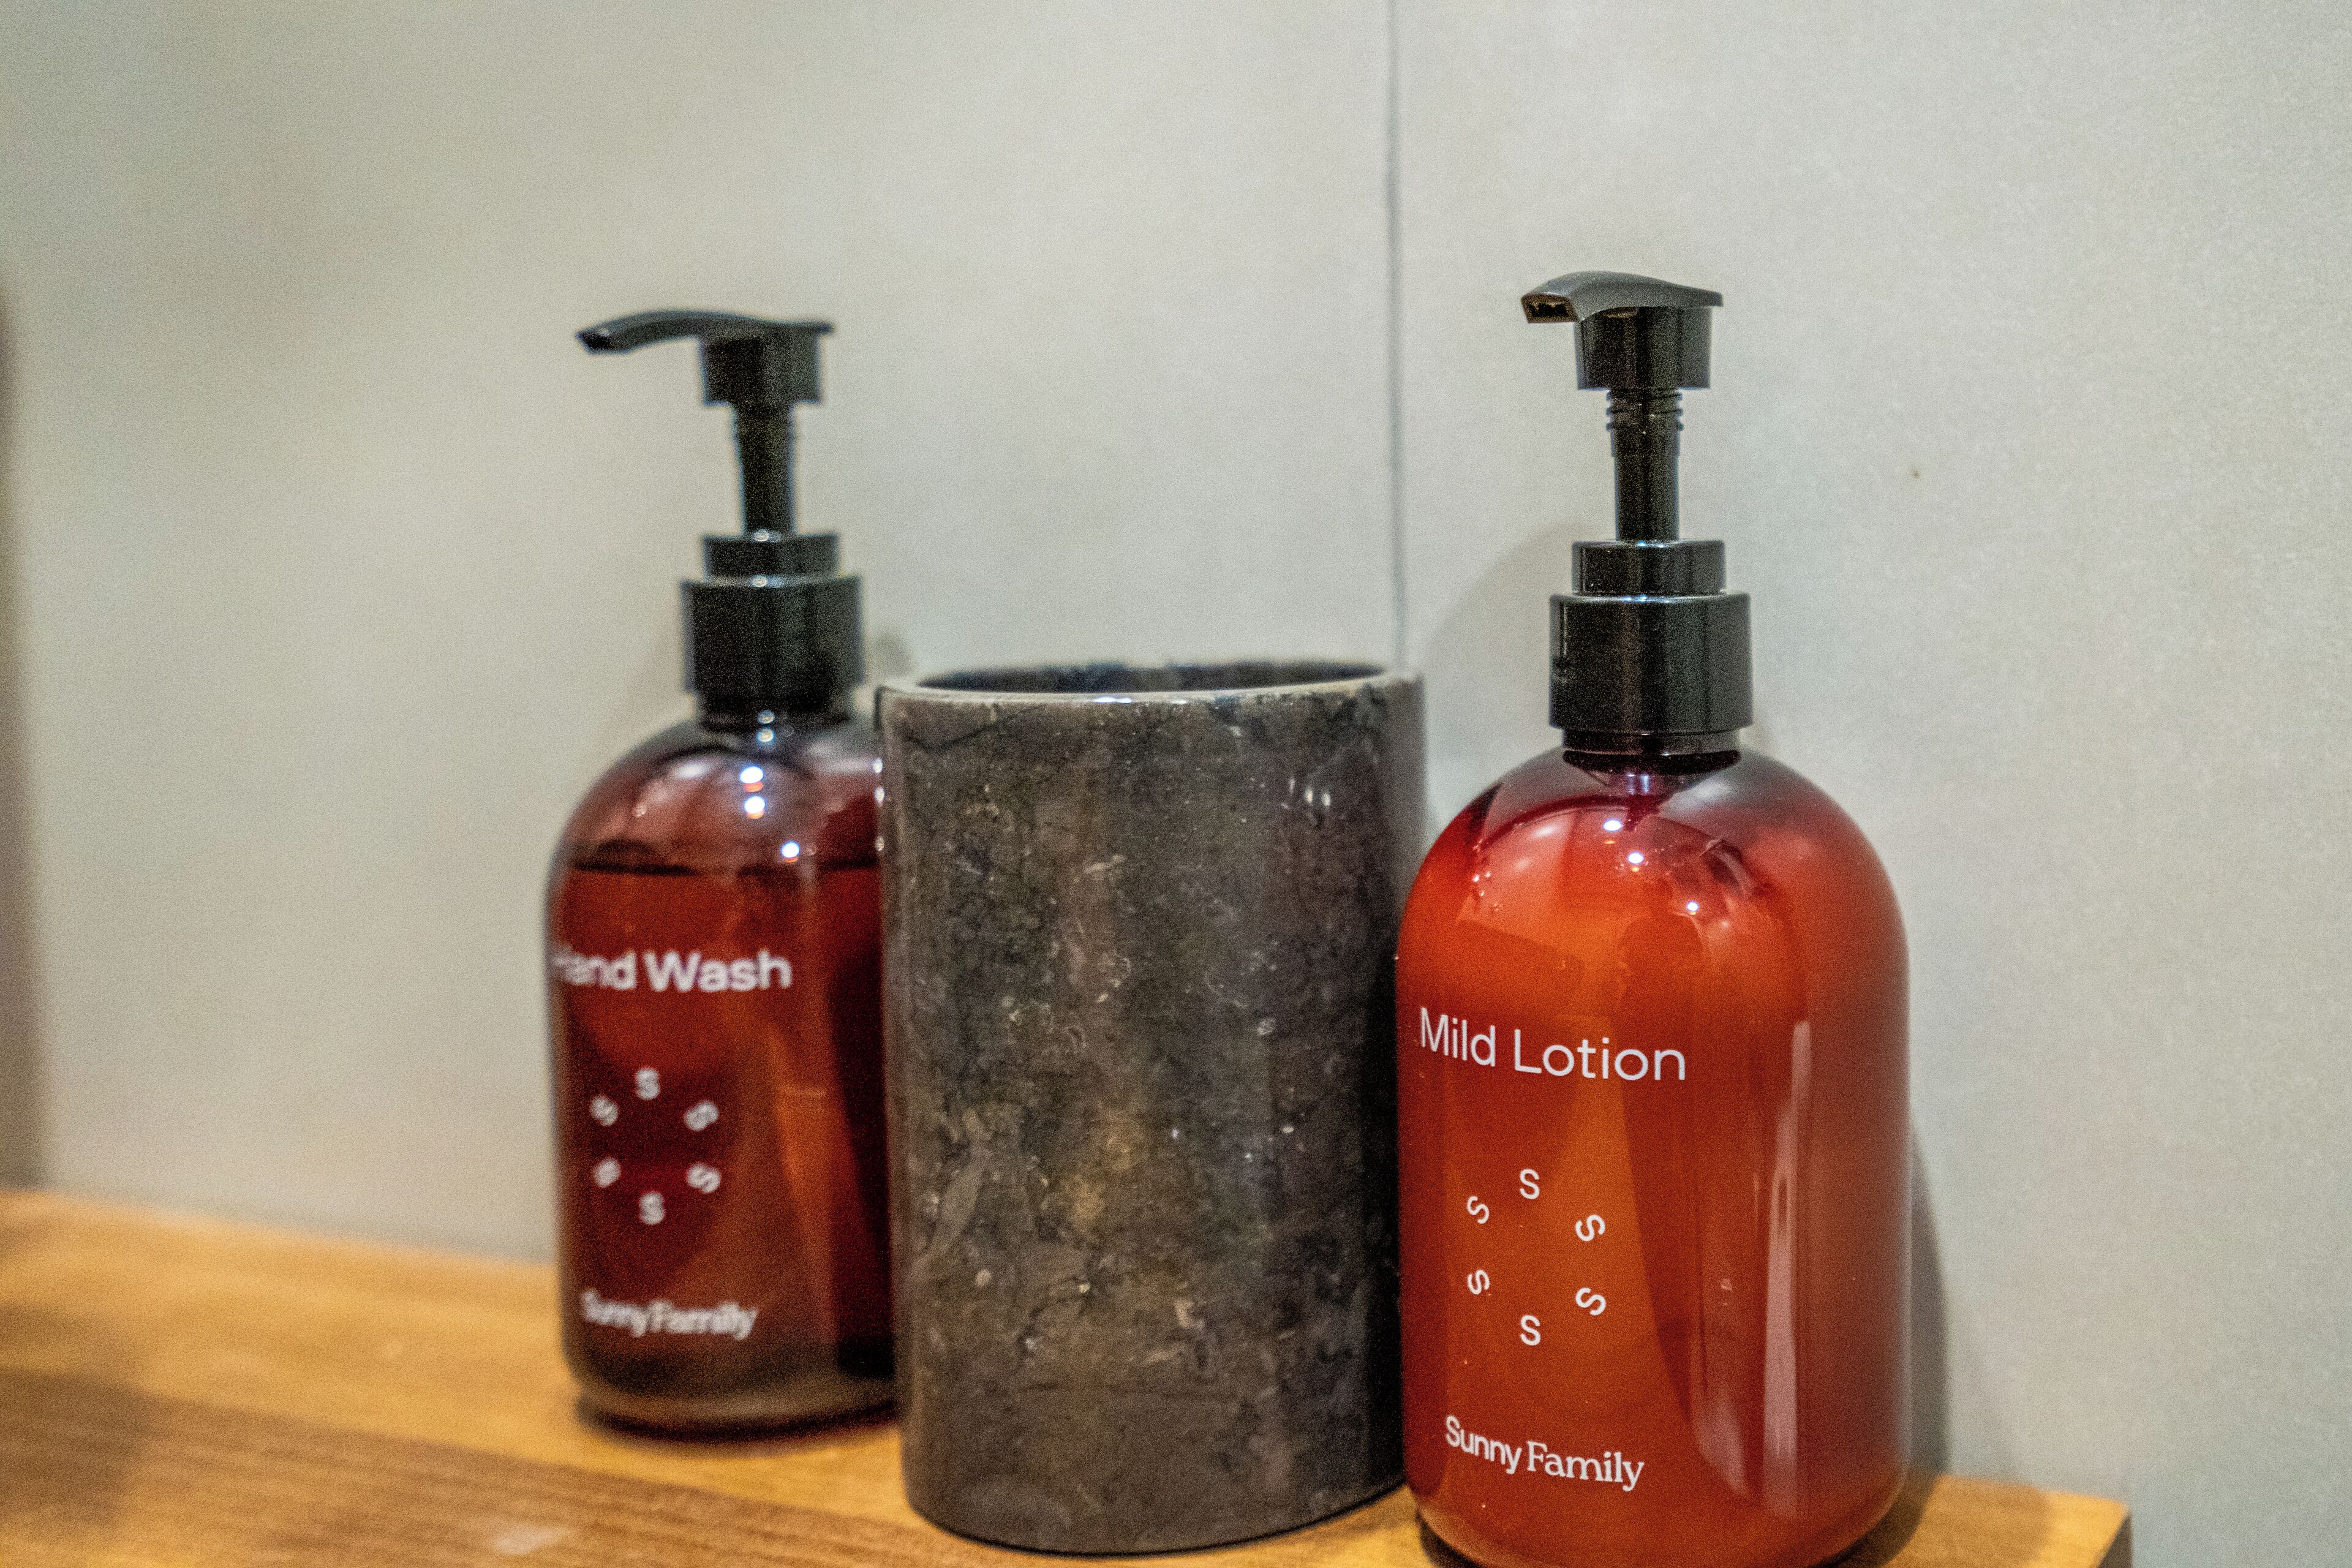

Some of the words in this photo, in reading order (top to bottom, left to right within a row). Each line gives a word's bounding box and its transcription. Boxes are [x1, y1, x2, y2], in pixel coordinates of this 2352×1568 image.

[643, 949, 792, 992] Wash
[1419, 1006, 1496, 1067] Mild
[1513, 1028, 1686, 1081] Lotion
[1518, 1167, 1540, 1200] S
[1466, 1196, 1490, 1224] S
[1574, 1213, 1606, 1243] S
[1466, 1269, 1490, 1295] S
[1574, 1287, 1607, 1316] S
[1519, 1314, 1542, 1346] S
[1445, 1414, 1522, 1476] Sunny
[1526, 1439, 1645, 1493] Family
